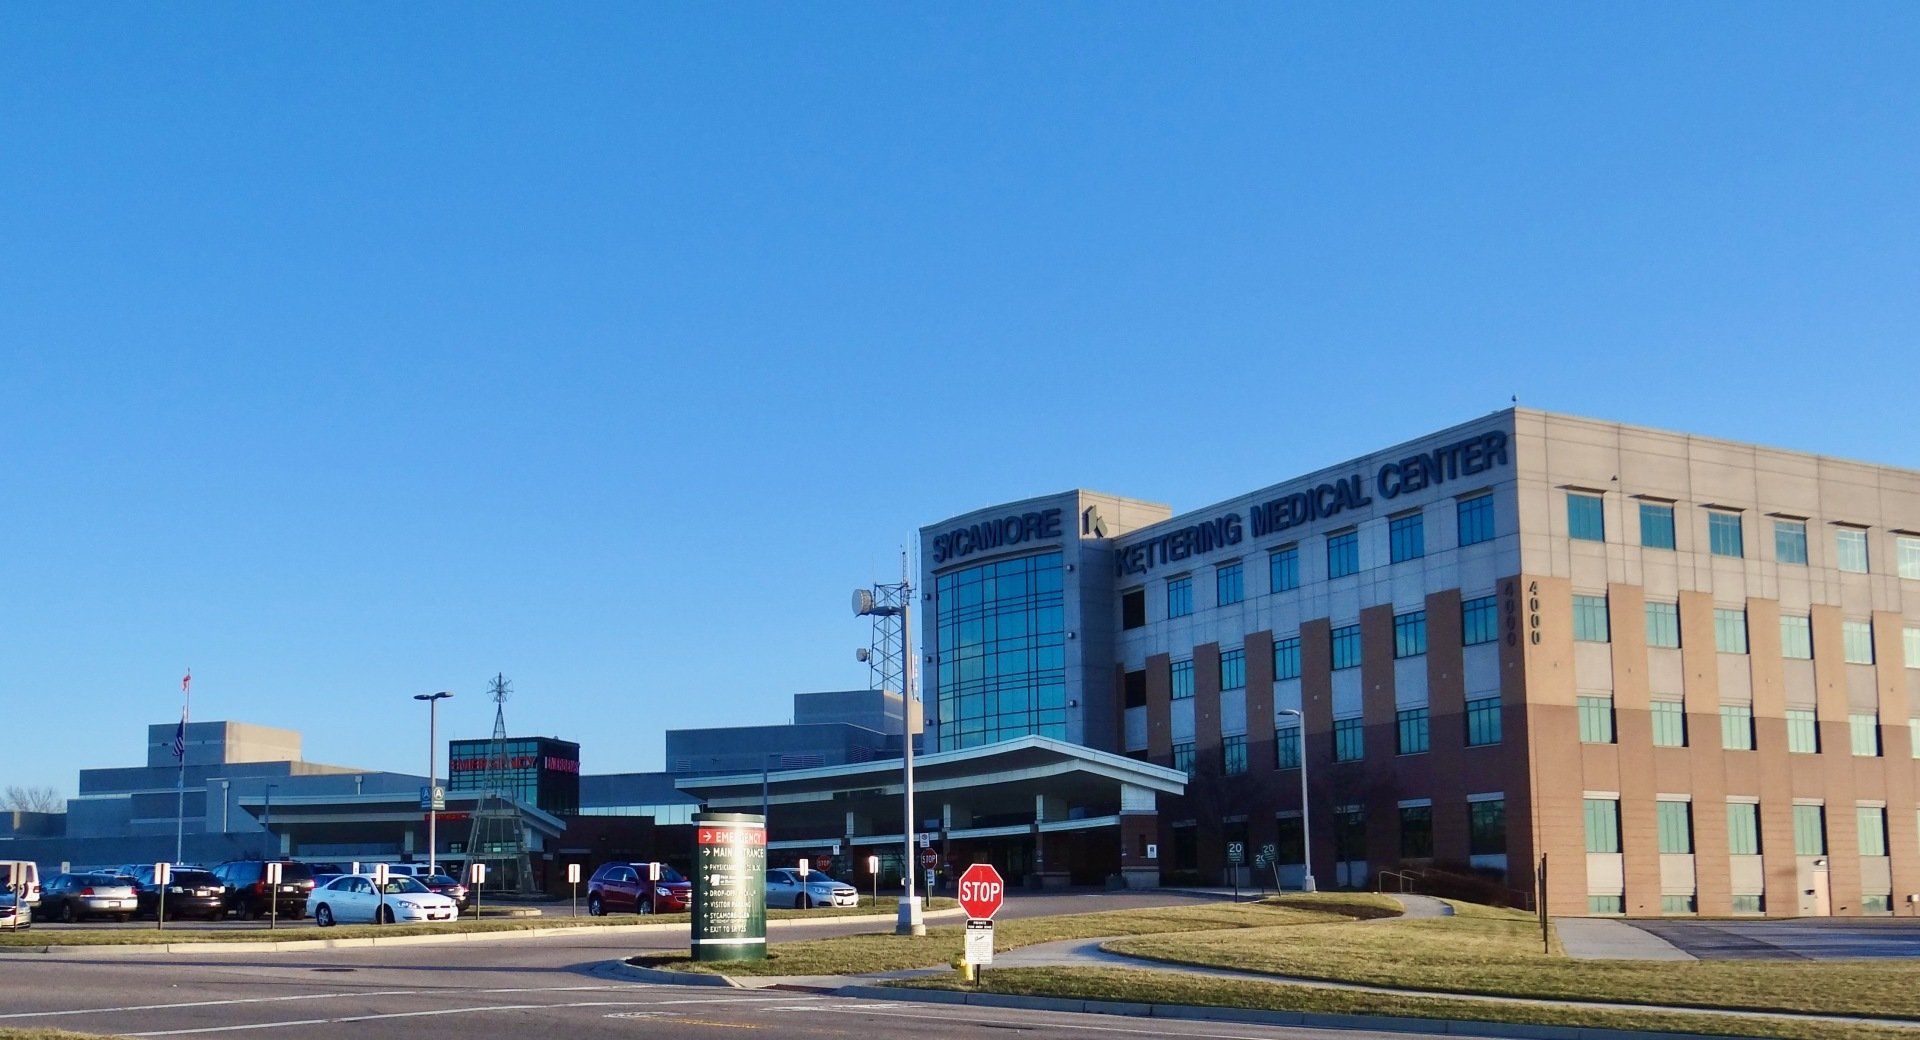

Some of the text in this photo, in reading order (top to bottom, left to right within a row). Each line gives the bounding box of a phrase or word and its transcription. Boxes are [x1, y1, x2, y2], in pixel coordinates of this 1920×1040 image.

[1115, 429, 1509, 577] KETTERING MEDICAL CENTER
[932, 508, 1063, 563] SYCAMORE
[1504, 581, 1517, 647] 4000
[1529, 580, 1541, 646] 4000
[451, 756, 537, 772] EMERNCY
[716, 831, 761, 843] EMEGENCY
[713, 847, 764, 859] MAIN TRANCE
[1229, 844, 1241, 852] 20
[1263, 845, 1274, 854] 20
[922, 855, 935, 864] STOP
[961, 881, 1000, 902] STOP
